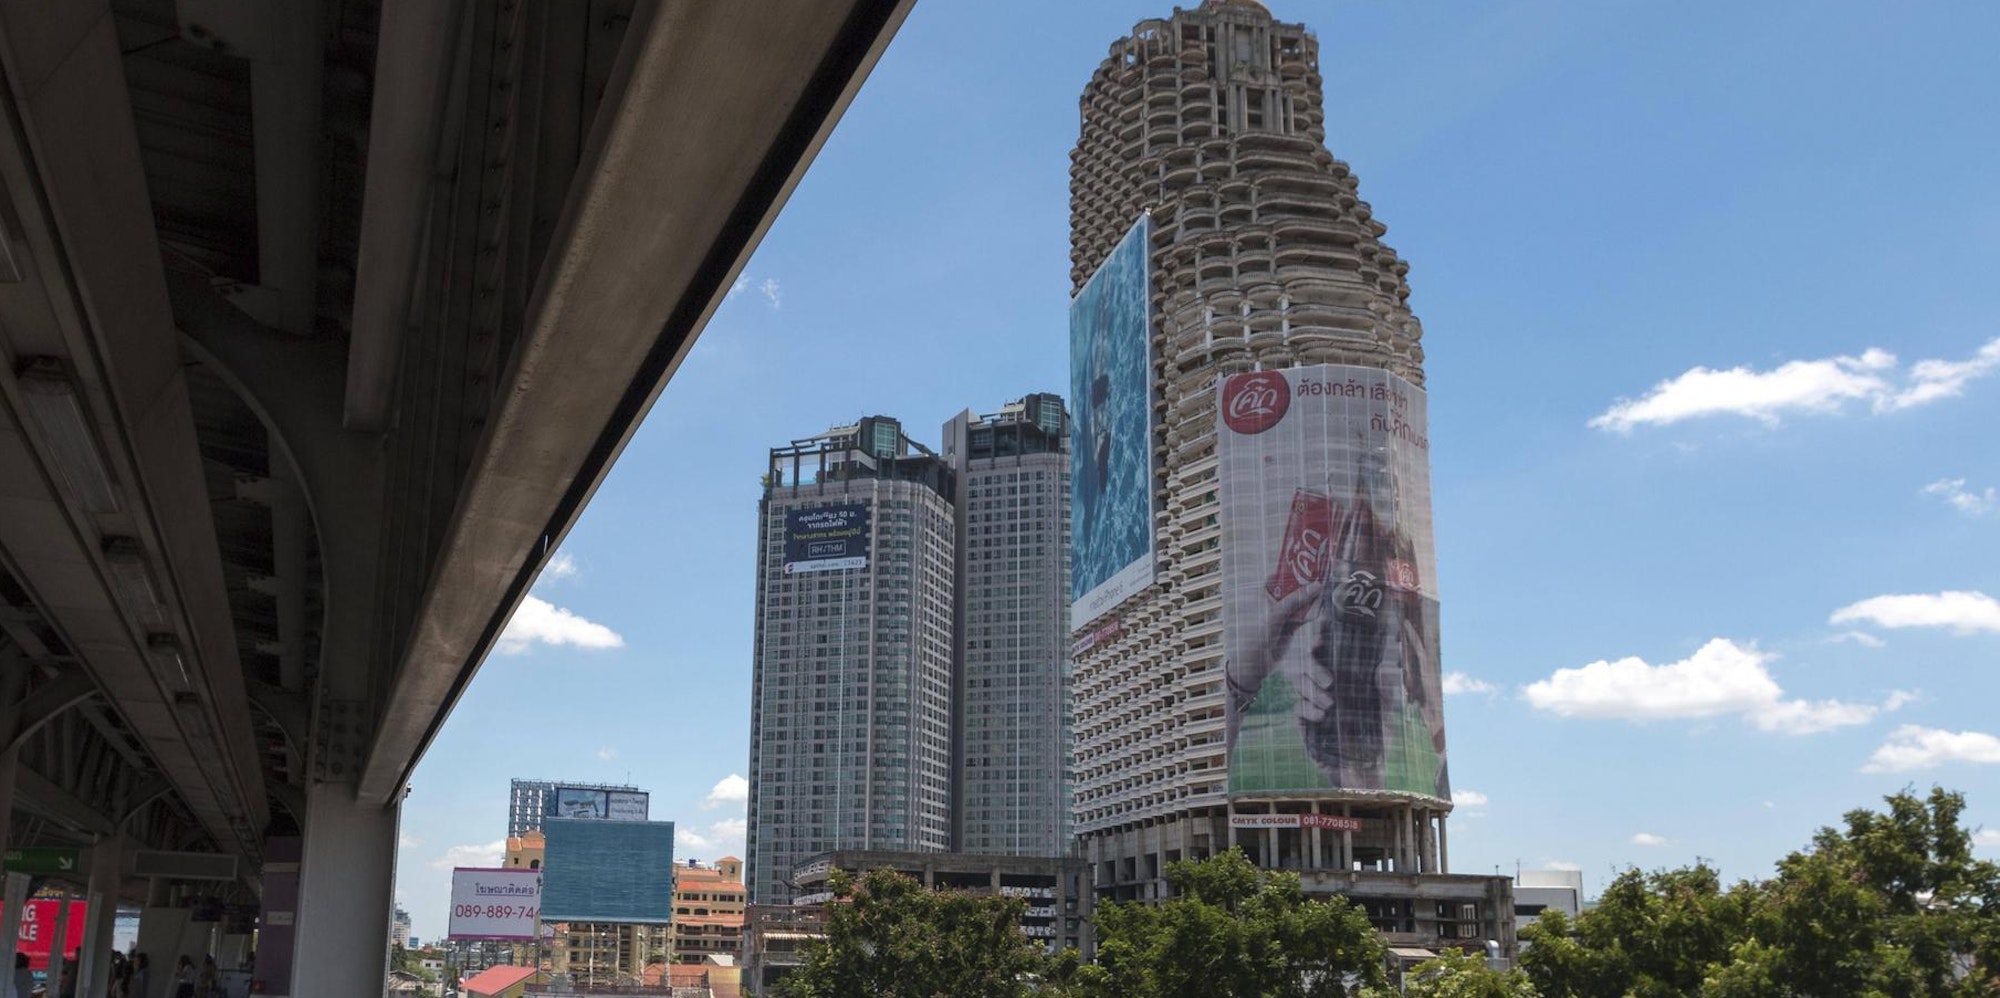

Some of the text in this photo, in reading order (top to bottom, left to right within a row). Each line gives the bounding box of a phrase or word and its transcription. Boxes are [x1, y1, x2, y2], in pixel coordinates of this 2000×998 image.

[1297, 378, 1364, 399] ต้องกล้า
[811, 544, 843, 554] RHYTHM
[1231, 816, 1358, 829] CMYK COLOUR 081-7708518
[475, 882, 535, 895] โฆษณาติดต่อ
[455, 904, 537, 919] 089-889-74
